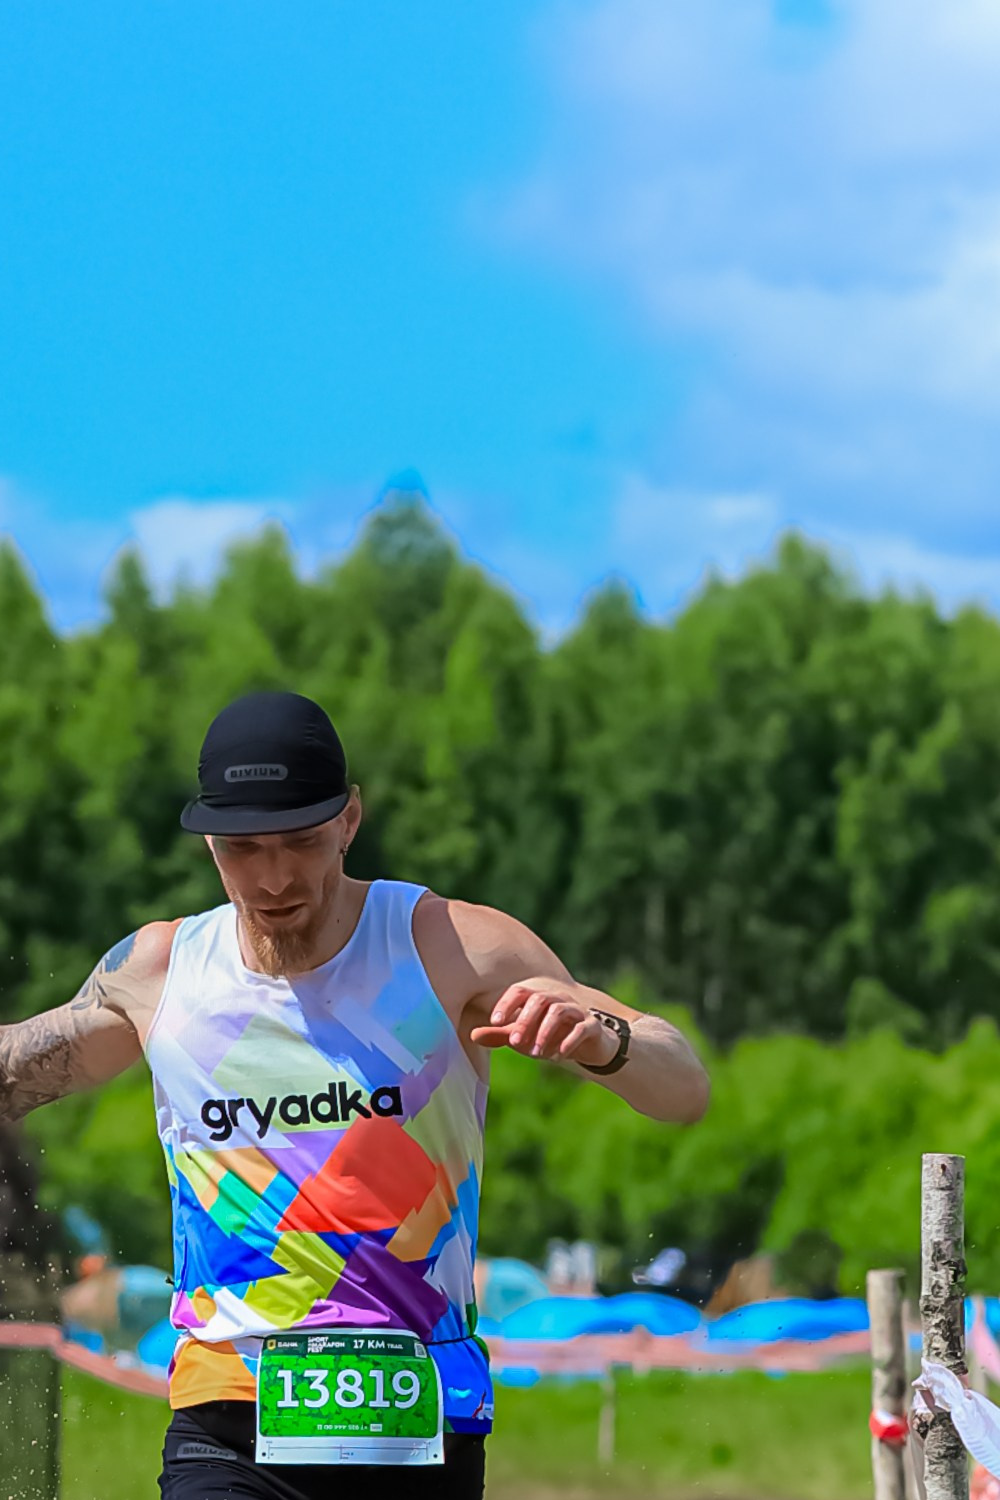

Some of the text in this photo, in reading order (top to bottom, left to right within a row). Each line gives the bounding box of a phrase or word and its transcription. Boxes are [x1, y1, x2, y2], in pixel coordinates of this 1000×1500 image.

[230, 768, 281, 778] BIVIUM
[201, 1081, 403, 1142] gryadka
[353, 1339, 365, 1349] 17
[367, 1339, 385, 1349] KM
[276, 1369, 421, 1409] 13819
